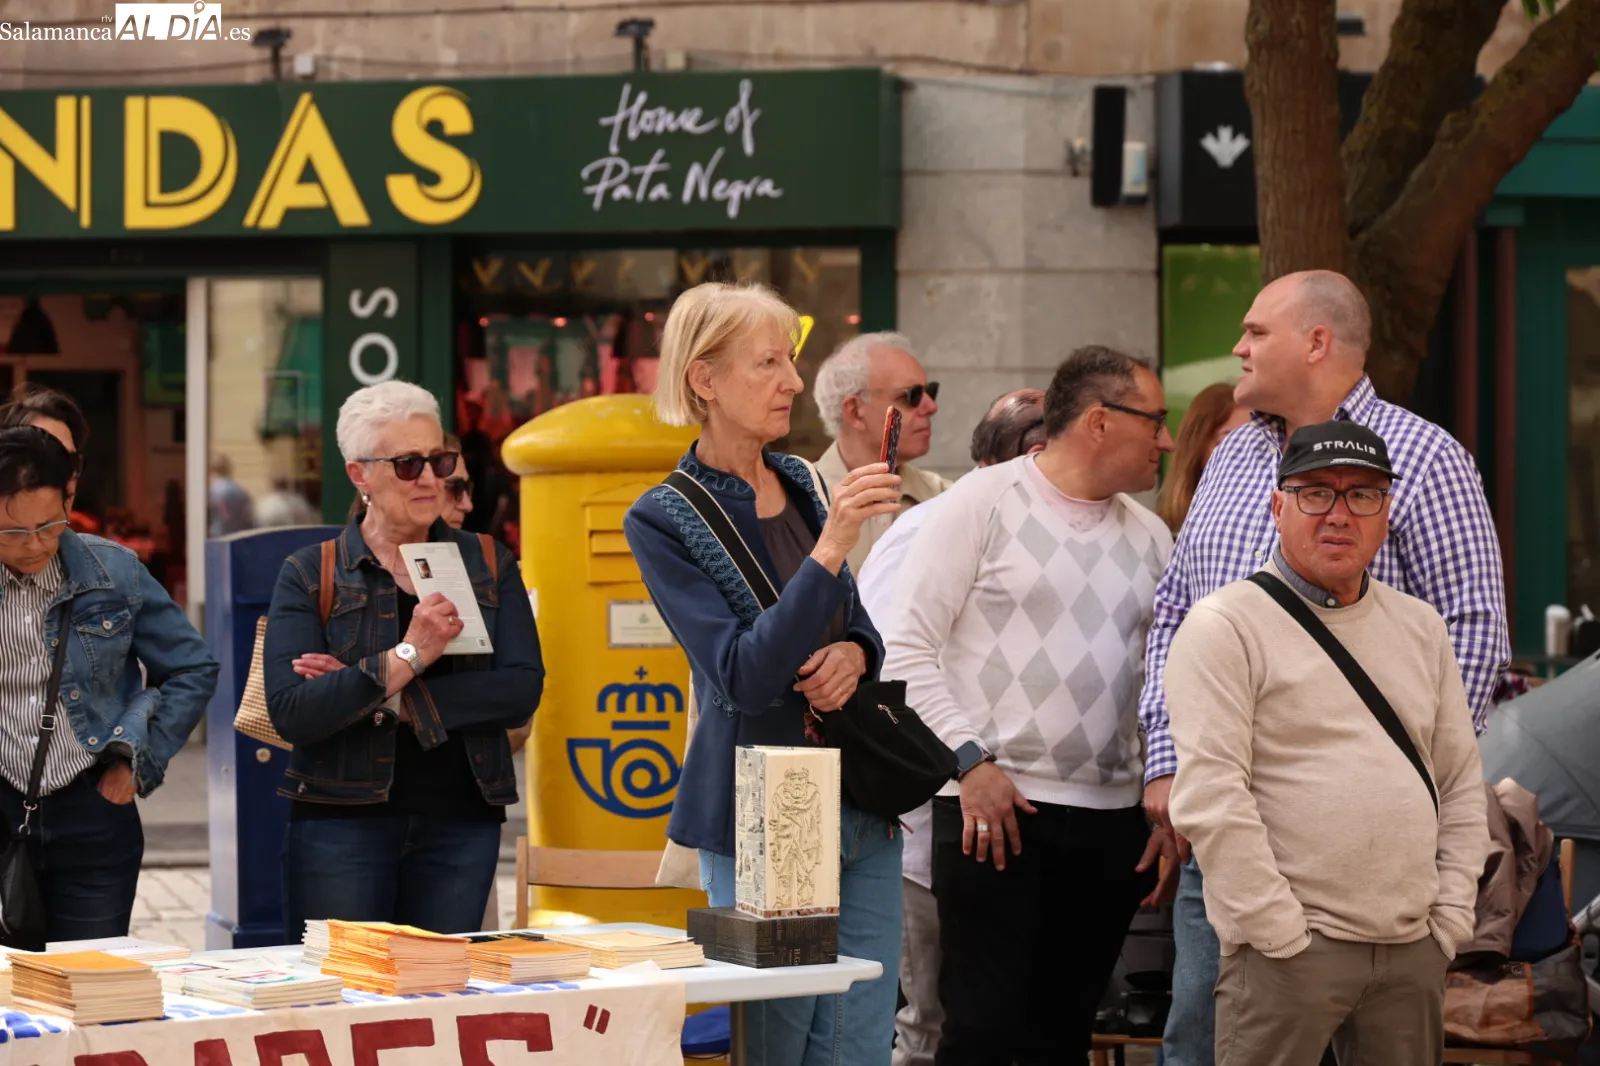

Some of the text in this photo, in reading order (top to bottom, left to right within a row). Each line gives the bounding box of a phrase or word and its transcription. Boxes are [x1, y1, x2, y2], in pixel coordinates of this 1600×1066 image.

[598, 78, 762, 157] Home of
[0, 85, 482, 231] NDAS
[580, 147, 783, 219] Pata Negra
[1313, 440, 1376, 455] STRALIS
